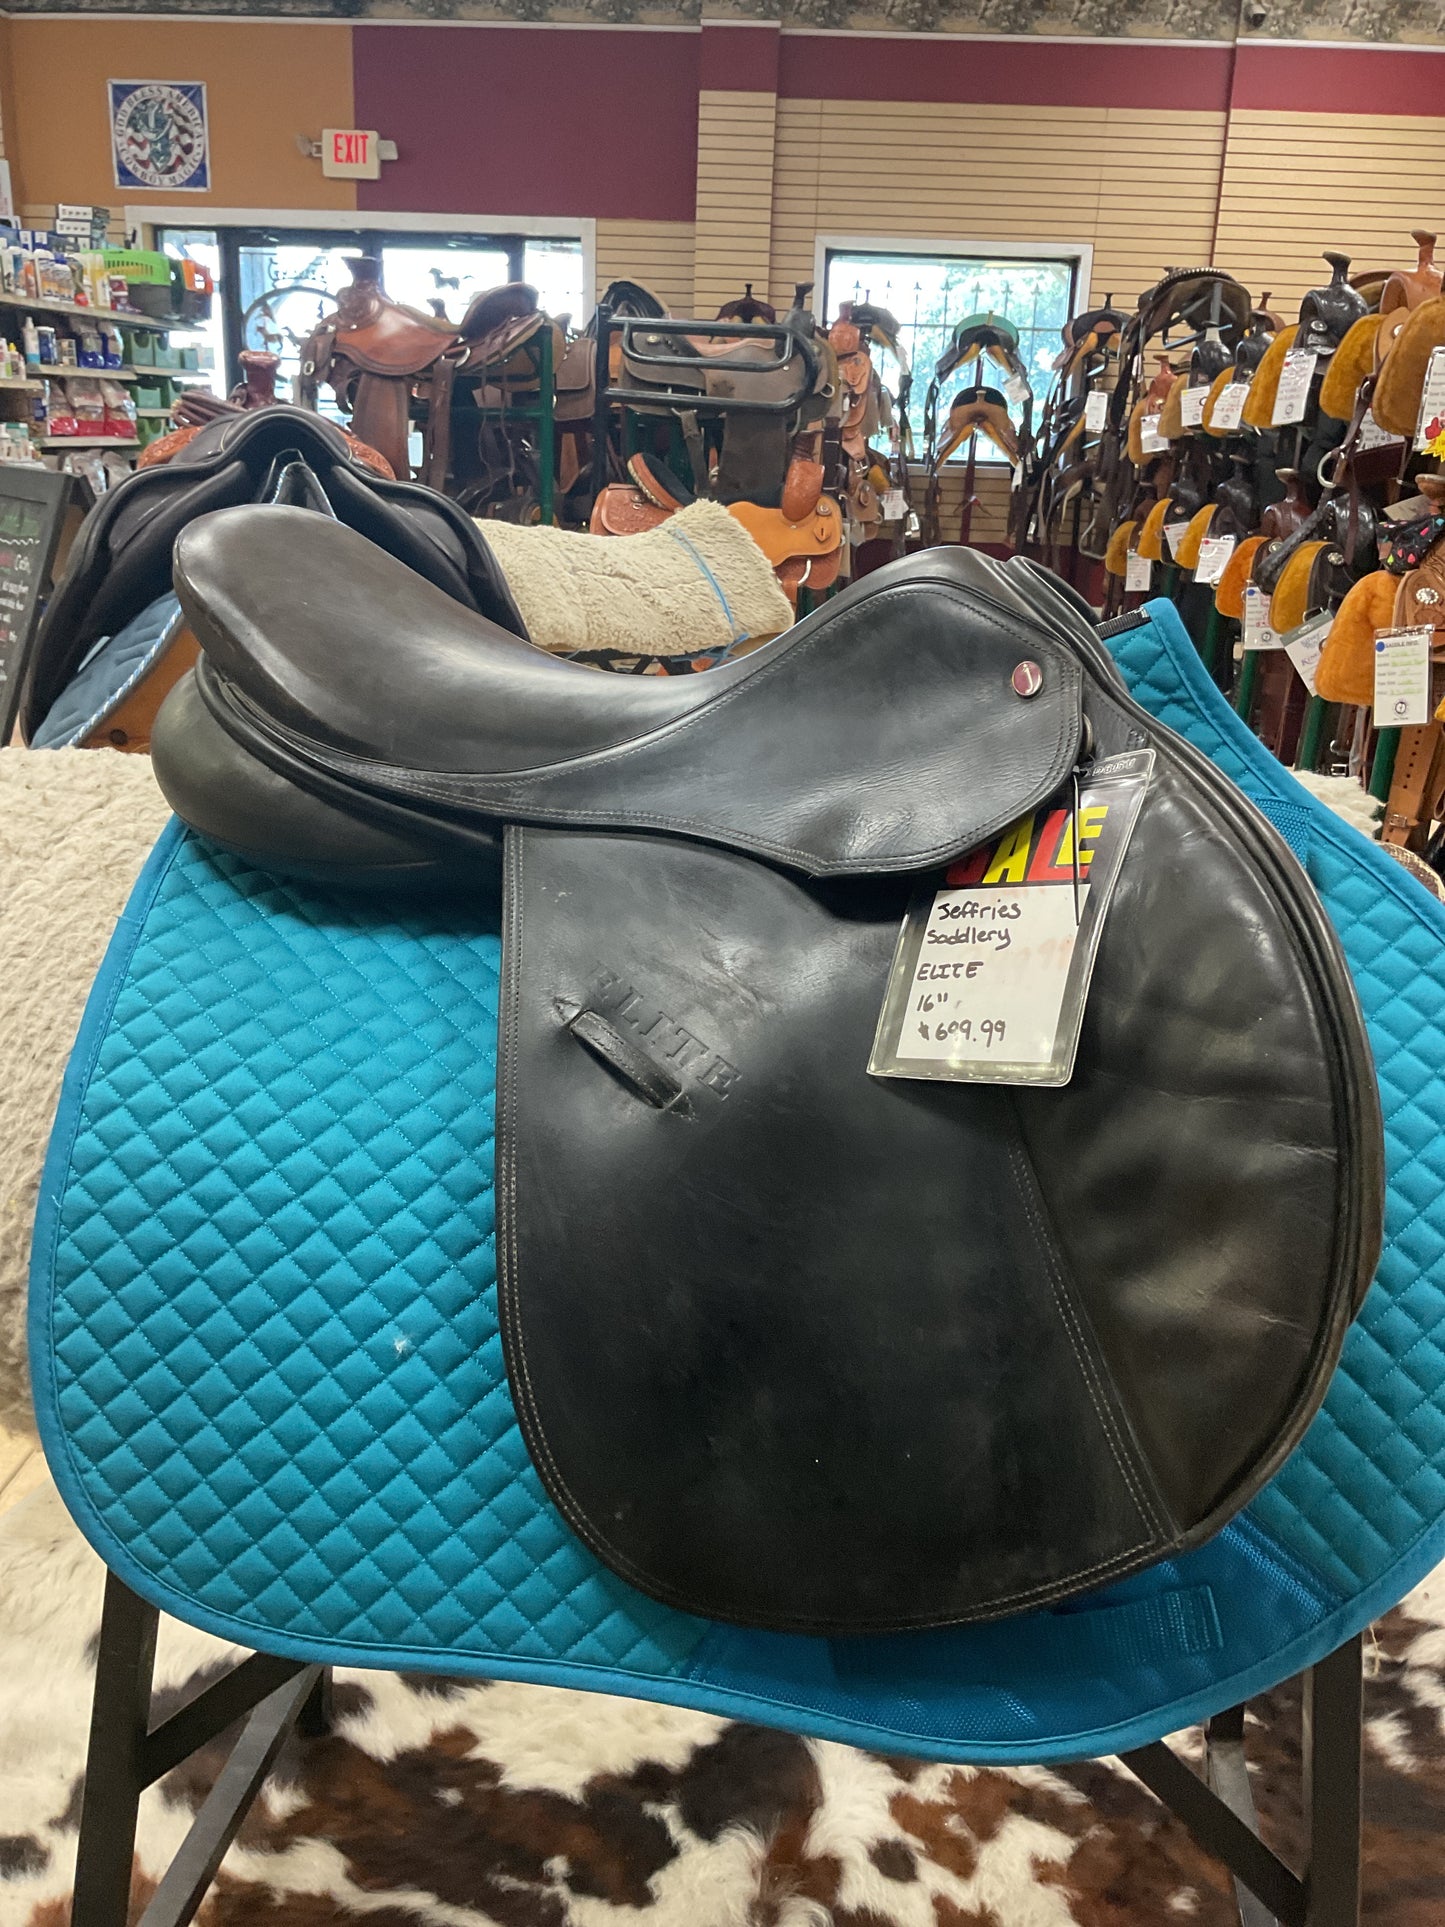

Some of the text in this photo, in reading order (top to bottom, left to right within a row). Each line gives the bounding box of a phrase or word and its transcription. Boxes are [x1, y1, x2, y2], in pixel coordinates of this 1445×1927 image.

[116, 86, 203, 139] GOD BLESS AMERICA
[333, 132, 369, 165] EXIT
[119, 147, 164, 184] COWBOY
[937, 898, 1022, 921] Jeffries
[927, 926, 1012, 951] Saddlery
[916, 961, 985, 981] ELITE
[916, 992, 949, 1013] 16"
[586, 960, 743, 1102] ELITE
